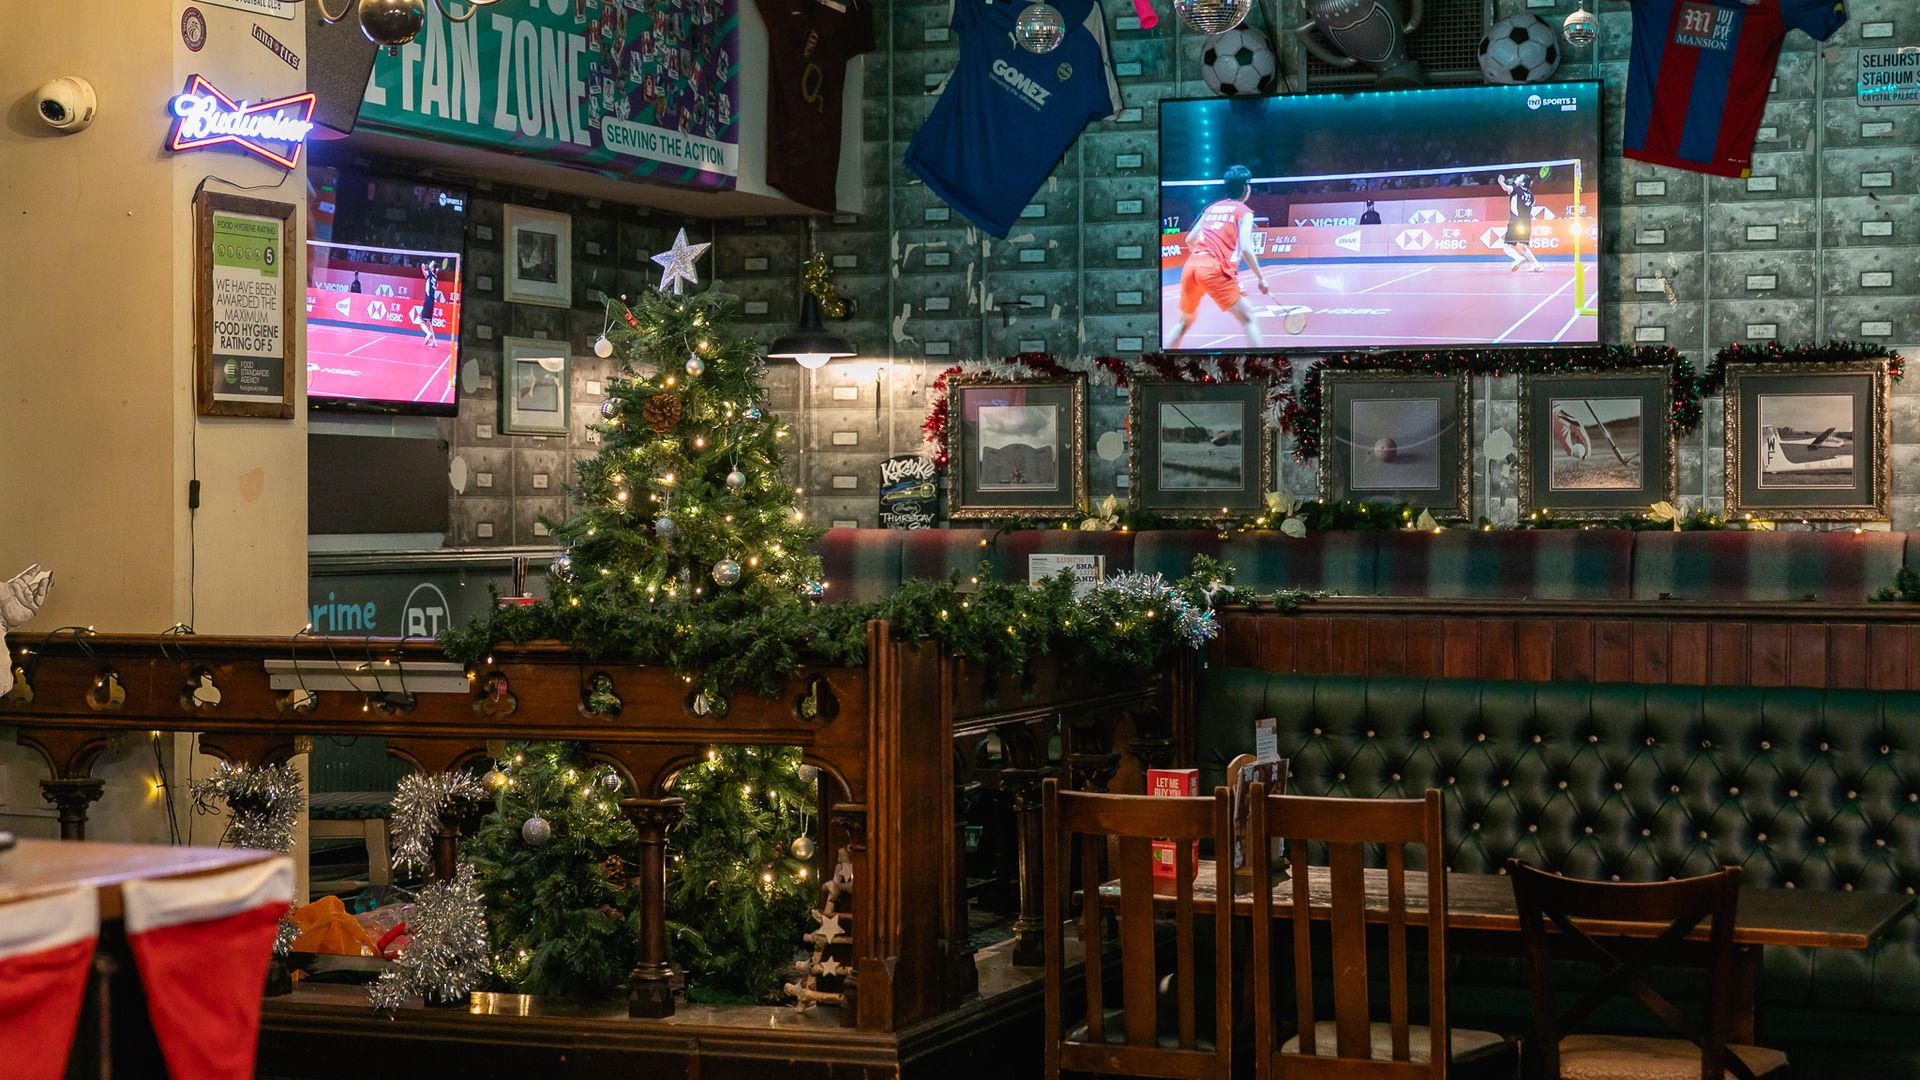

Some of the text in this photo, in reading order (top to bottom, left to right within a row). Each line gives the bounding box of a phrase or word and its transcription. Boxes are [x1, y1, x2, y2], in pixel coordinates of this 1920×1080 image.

[1676, 34, 1728, 51] MANSION
[1863, 53, 1920, 68] SELHURST
[403, 0, 481, 124] FAN
[492, 13, 592, 147] ZONE
[1862, 71, 1913, 85] STADIUM
[993, 59, 1051, 106] GOMEZ
[1542, 98, 1571, 106] SPORTS
[1862, 92, 1918, 102] CRYSTAL PALACE
[174, 93, 313, 142] Budweiser
[606, 124, 724, 166] SERVING THE ACTION
[217, 220, 276, 235] FOOD HYGIENE RATING
[1168, 216, 1179, 228] 17
[1310, 217, 1357, 227] VICTOR
[1434, 239, 1468, 250] HSBC
[266, 248, 273, 264] 5
[216, 279, 277, 296] WE HAVE BEEN
[216, 293, 277, 311] AWARDED THE
[224, 308, 269, 324] MAXIMUM
[386, 312, 404, 323] HSBC
[1314, 307, 1392, 315] HSBC
[215, 320, 279, 339] FOOD HYGIENE
[220, 336, 273, 352] RATING OF 5
[240, 361, 254, 369] FOOD
[240, 368, 270, 378] STANDARDS
[240, 375, 260, 384] AGENCY
[880, 513, 936, 524] THURSDAY
[1156, 777, 1179, 789] LET ME
[1154, 787, 1168, 797] BUY
[1168, 788, 1181, 798] YOU
